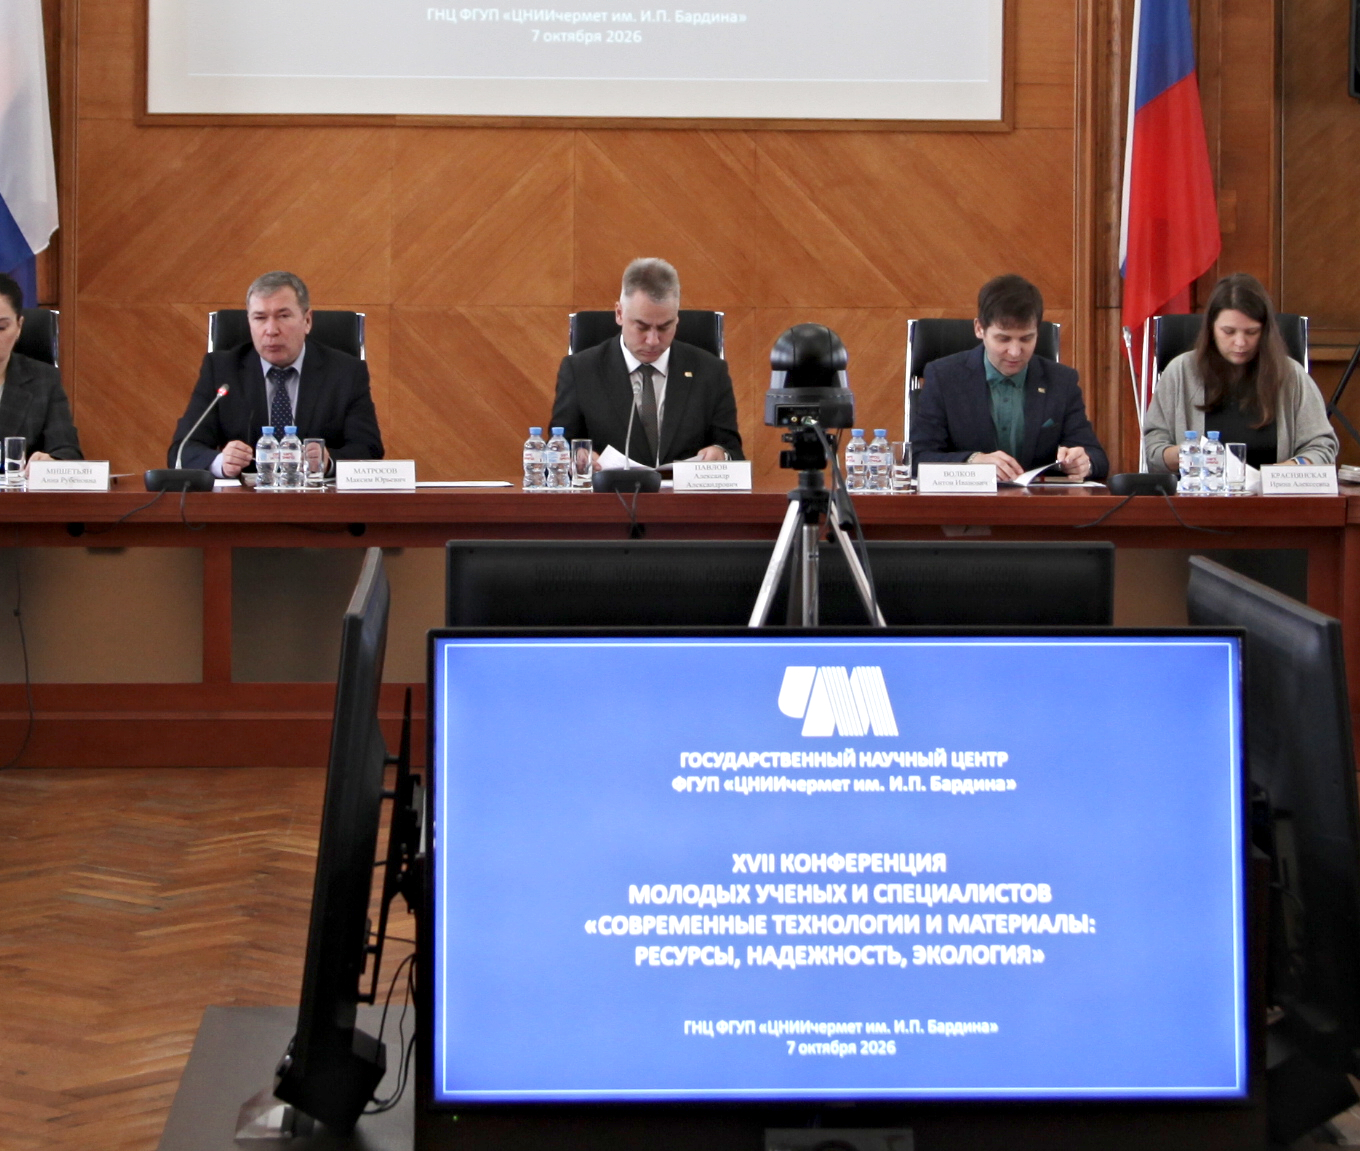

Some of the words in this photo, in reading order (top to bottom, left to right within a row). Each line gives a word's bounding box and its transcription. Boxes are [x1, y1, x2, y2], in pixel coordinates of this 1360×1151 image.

[427, 7, 457, 24] ГНЦ
[459, 8, 500, 21] ФГУП
[503, 9, 608, 25] «ЦНИИчермет
[611, 12, 637, 22] им.
[640, 9, 671, 22] И.П.
[674, 9, 747, 26] Бардина»
[531, 29, 540, 42] 7
[543, 29, 602, 45] октября
[605, 29, 643, 43] 2026
[353, 467, 398, 475] МАТРОСОВ
[679, 747, 857, 772] ГОСУДАРСТВЕННЫЙ
[858, 747, 948, 768] НАУЧНЫЙ
[950, 750, 1010, 771] ЦЕНТР
[671, 775, 720, 793] ФГУП
[723, 775, 852, 796] «ЦНИИчермет
[853, 778, 886, 793] им.
[888, 775, 927, 792] И.П.
[929, 775, 1018, 796] Бардина»
[731, 852, 776, 874] XVII
[780, 852, 947, 876] КОНФЕРЕНЦИЯ
[628, 883, 751, 908] МОЛОДЫХ
[754, 883, 848, 904] УЧЕНЫХ
[851, 883, 869, 904] И
[873, 882, 1053, 907] СПЕЦИАЛИСТОВ
[583, 914, 768, 937] «СОВРЕМЕННЫЕ
[771, 914, 921, 935] ТЕХНОЛОГИИ
[925, 914, 942, 934] И
[947, 913, 1097, 935] МАТЕРИАЛЫ:
[634, 945, 742, 970] РЕСУРСЫ,
[746, 945, 908, 970] НАДЕЖНОСТЬ,
[911, 944, 1046, 966] ЭКОЛОГИЯ»
[683, 1019, 715, 1039] ГНЦ
[715, 1019, 757, 1036] ФГУП
[758, 1019, 864, 1038] «ЦНИИчермет
[865, 1021, 892, 1035] им.
[893, 1018, 925, 1035] И.П.
[927, 1018, 1000, 1038] Бардина»
[786, 1040, 797, 1056] 7
[797, 1039, 858, 1059] октября
[859, 1039, 897, 1056] 2026
